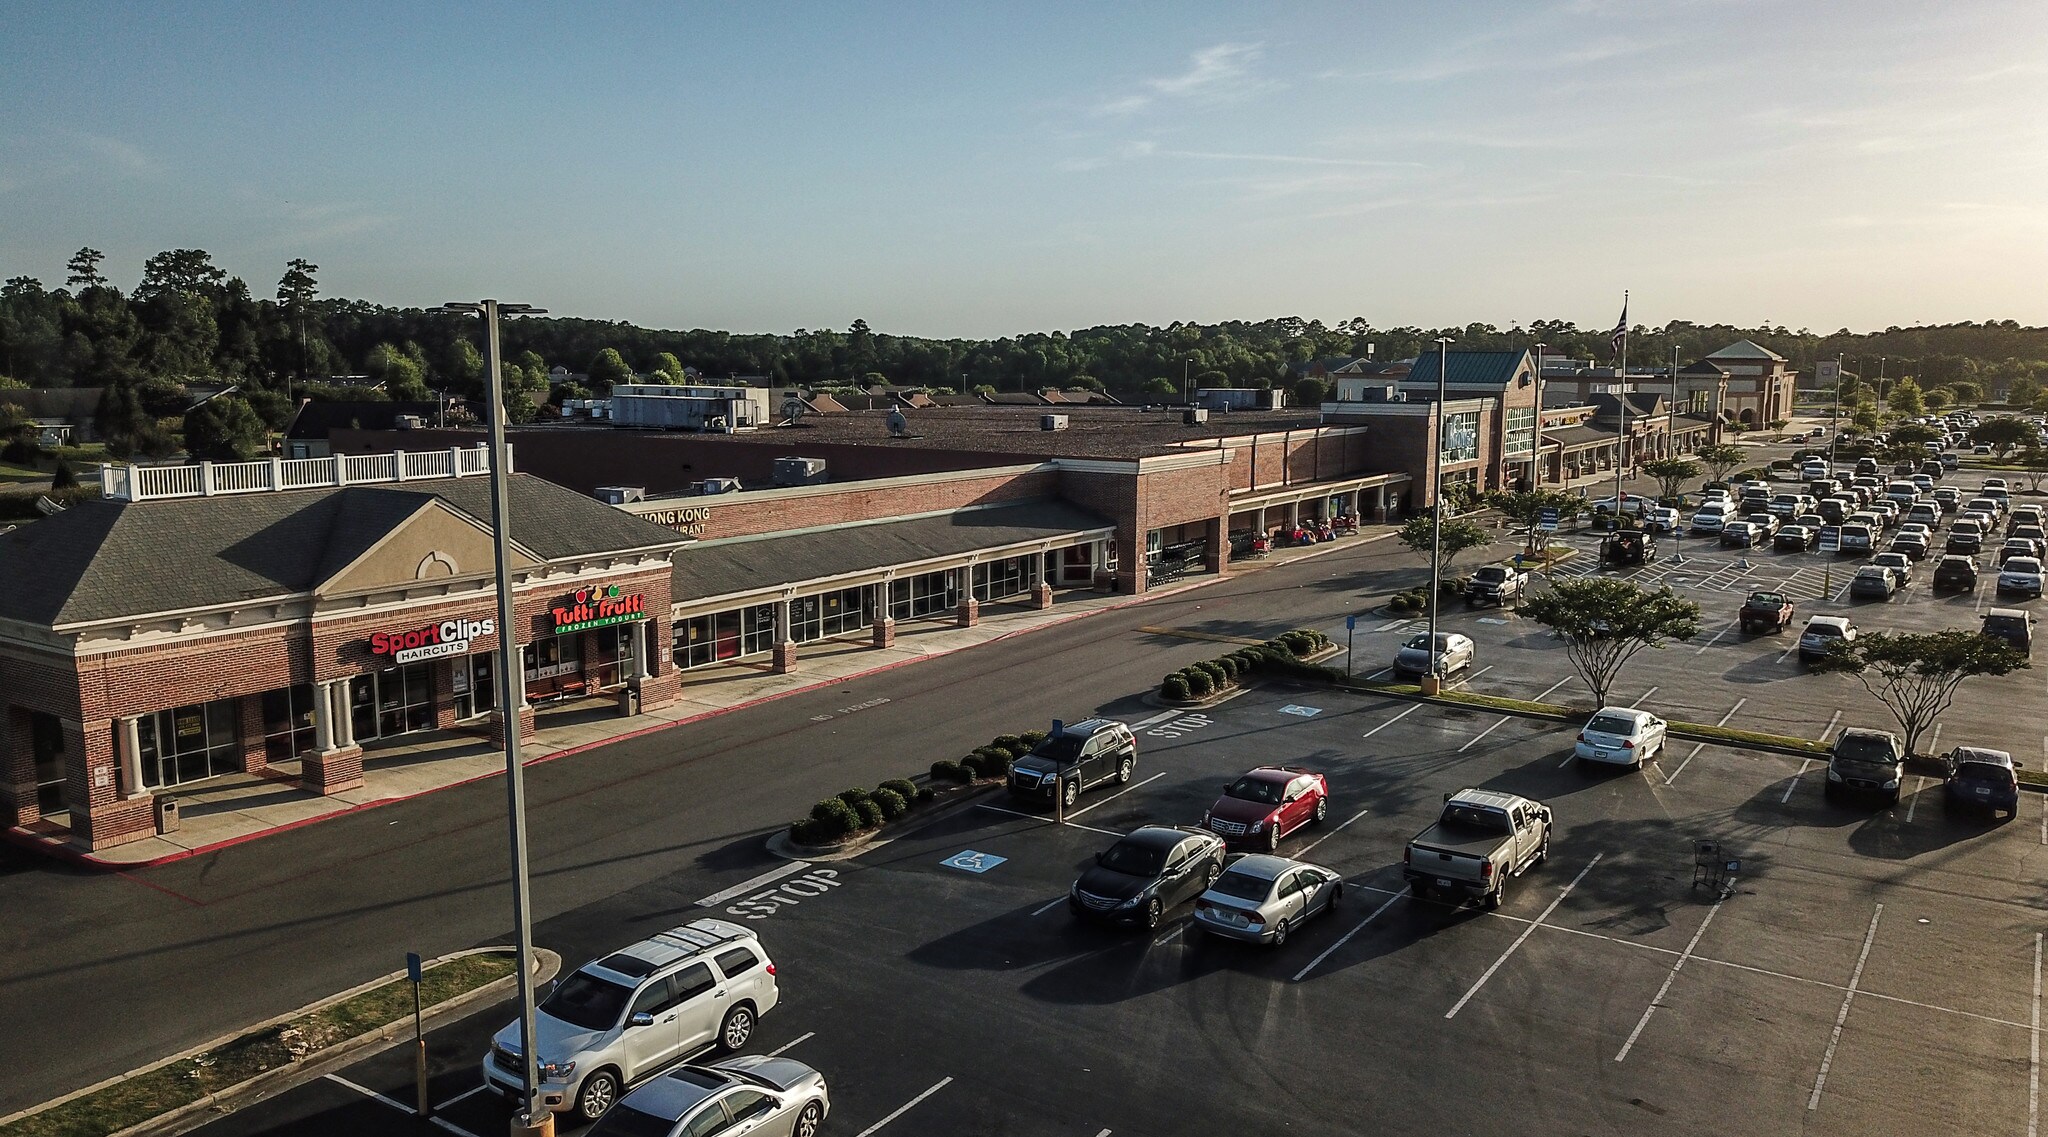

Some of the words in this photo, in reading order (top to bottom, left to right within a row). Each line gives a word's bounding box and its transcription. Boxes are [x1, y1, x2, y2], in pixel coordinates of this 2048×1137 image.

[677, 507, 710, 522] KONG
[552, 602, 594, 625] Tutti
[561, 621, 599, 632] FROZEN
[604, 612, 642, 624] YOGURT
[401, 642, 464, 660] HAIRCUTS
[1146, 713, 1214, 739] STOP
[725, 869, 842, 919] STOP
